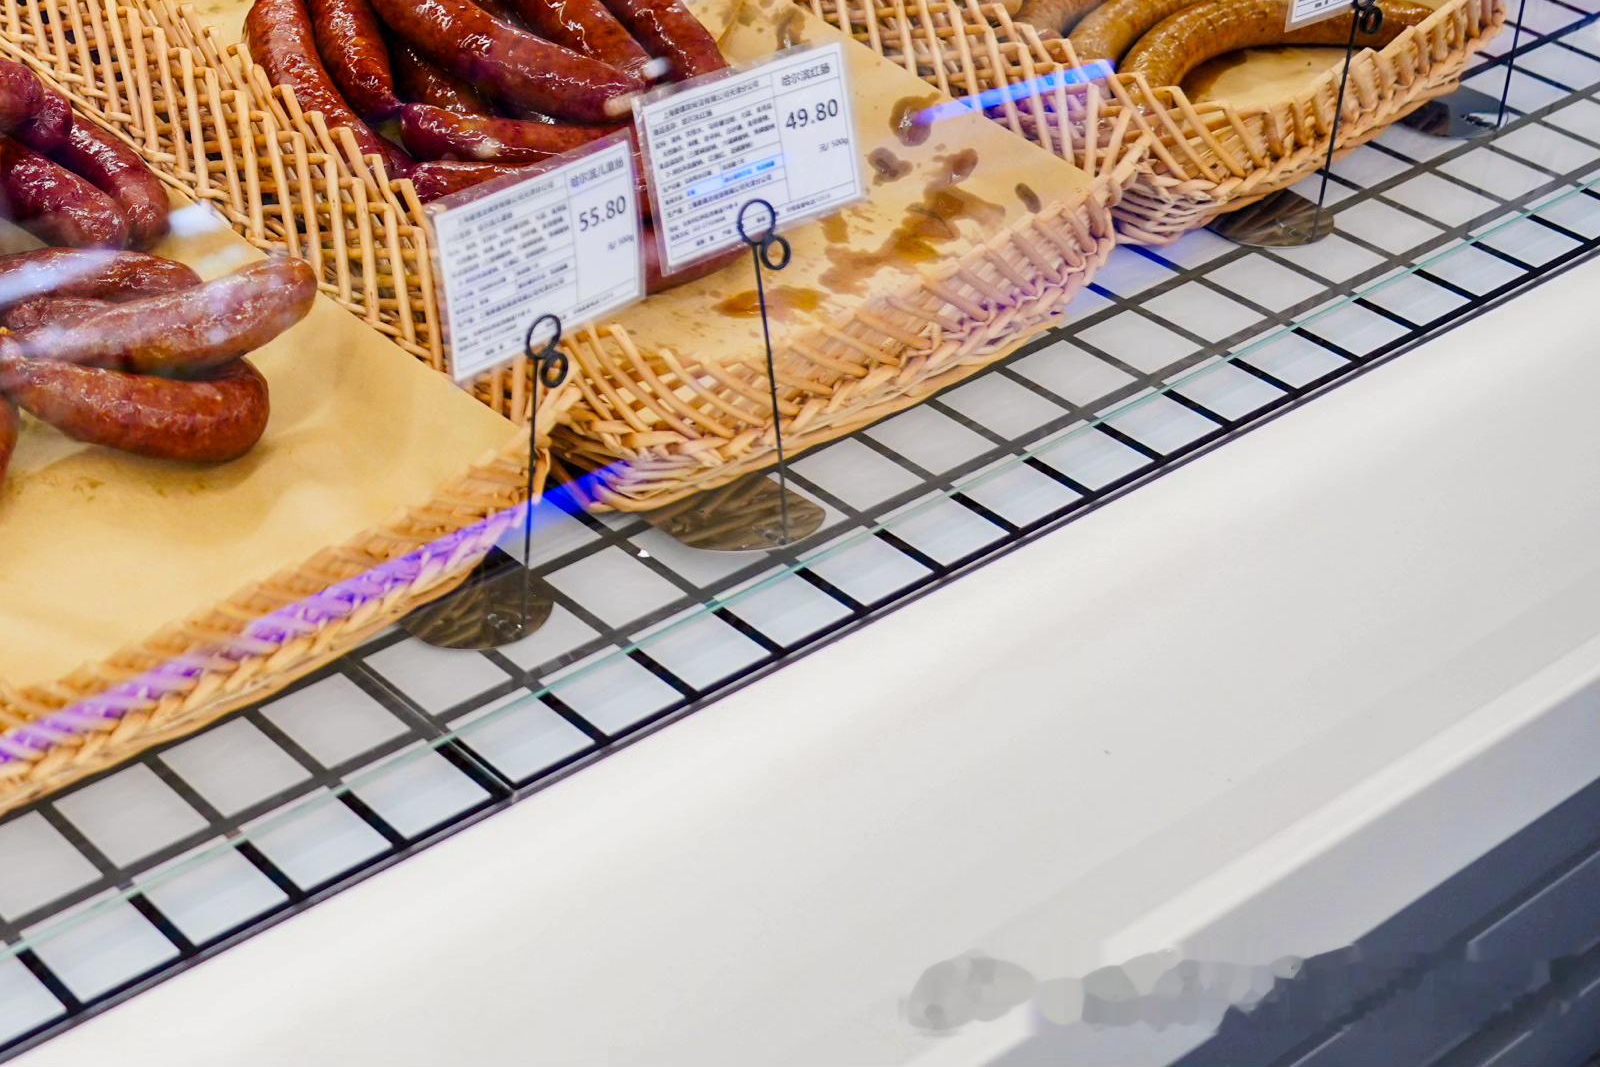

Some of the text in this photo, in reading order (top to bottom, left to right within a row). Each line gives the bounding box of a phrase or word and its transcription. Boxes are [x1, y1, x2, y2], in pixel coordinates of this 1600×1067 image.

[781, 62, 831, 87] 哈尔滨红肠
[785, 98, 839, 130] 49.80
[579, 195, 626, 232] 55.80
